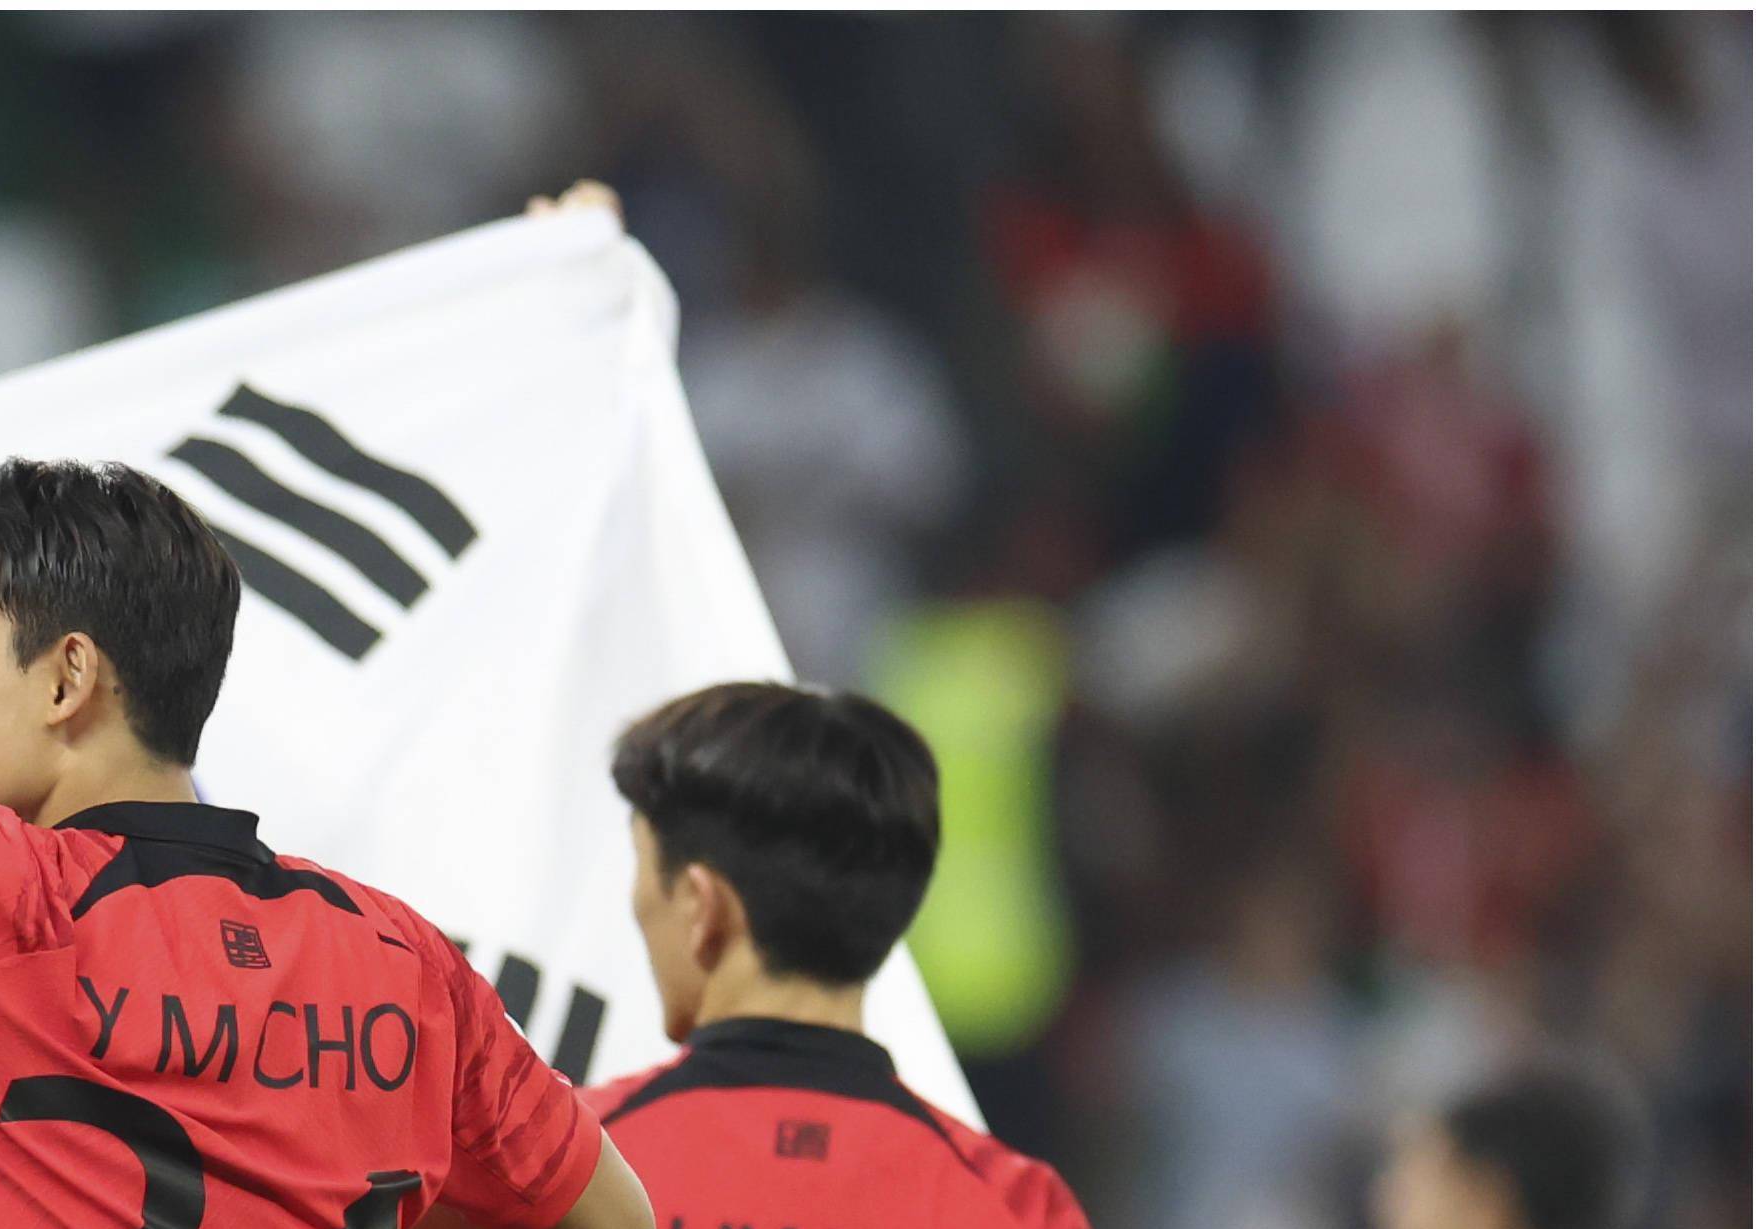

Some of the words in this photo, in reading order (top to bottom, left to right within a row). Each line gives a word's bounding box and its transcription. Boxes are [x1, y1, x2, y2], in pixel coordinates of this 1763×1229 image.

[76, 976, 129, 1060] Y
[154, 994, 239, 1083] M
[253, 1000, 416, 1092] CHO
